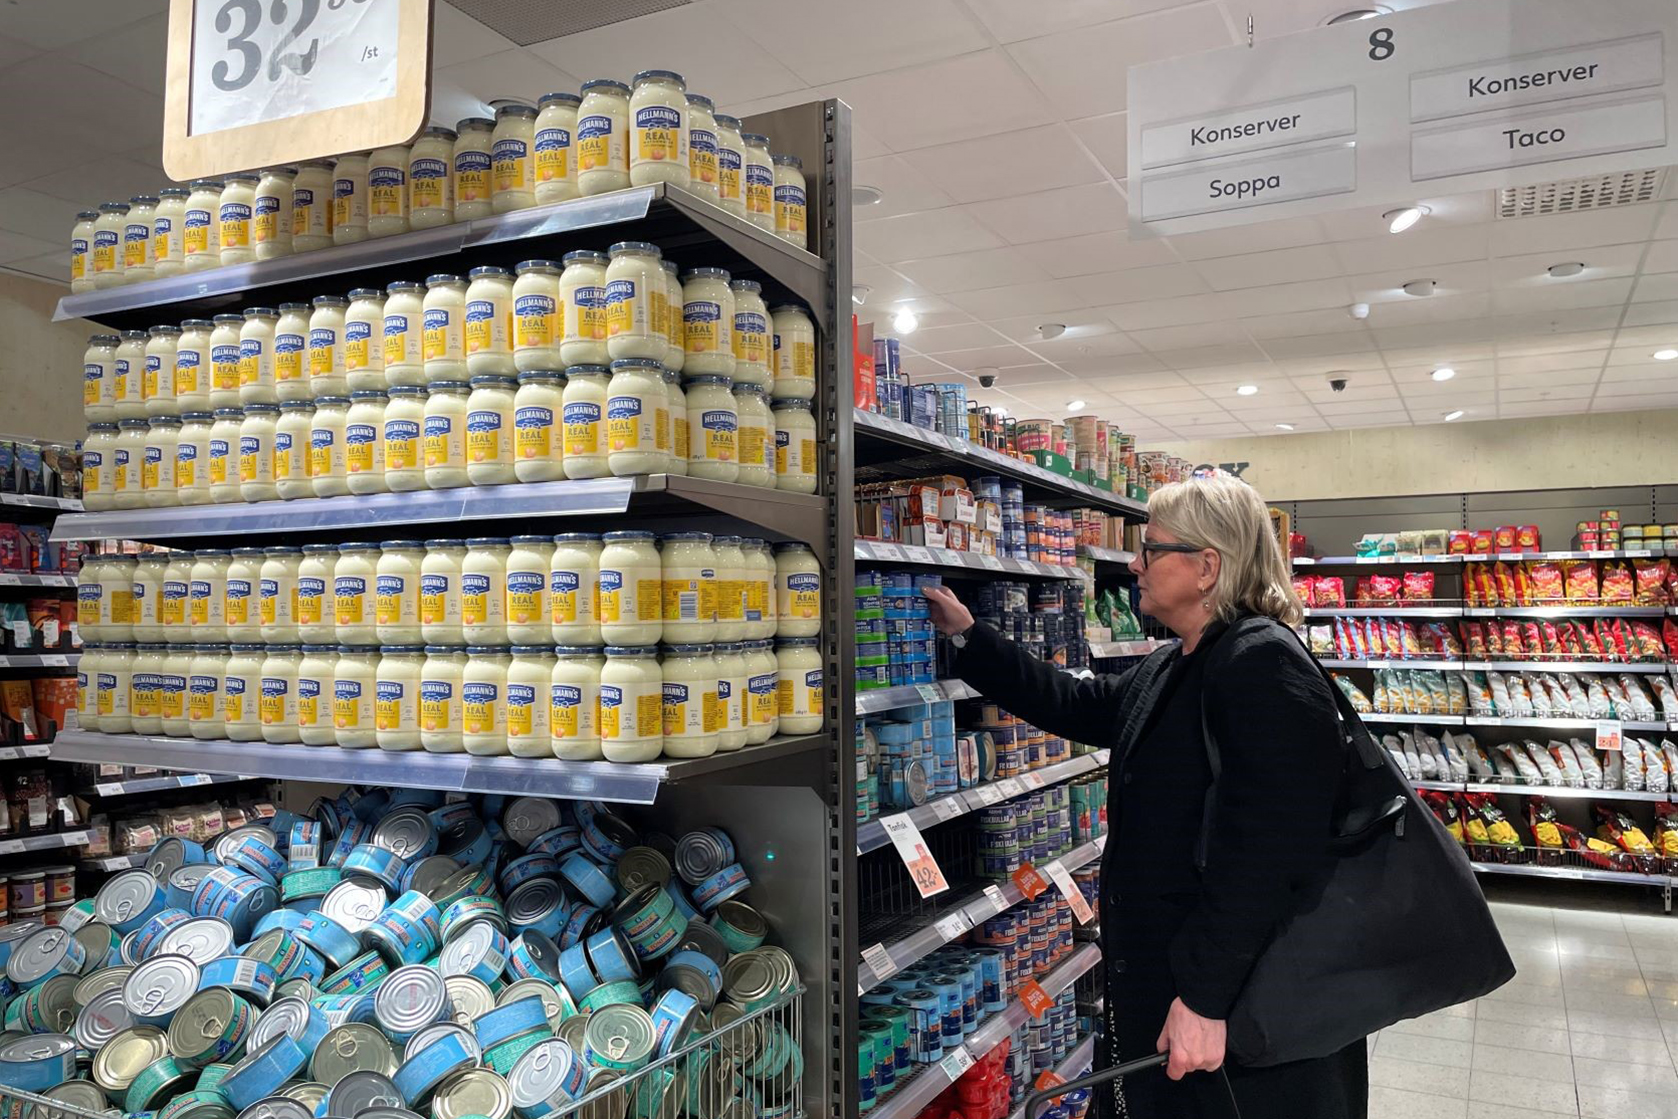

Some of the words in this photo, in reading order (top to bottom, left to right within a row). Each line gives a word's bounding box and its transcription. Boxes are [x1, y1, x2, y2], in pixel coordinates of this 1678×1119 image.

[1368, 28, 1394, 60] 8
[361, 46, 378, 62] /st
[1469, 61, 1598, 98] Konserver
[638, 109, 679, 124] HELLMANN'S
[1191, 114, 1300, 146] Konserver
[645, 130, 672, 142] REAL
[1503, 126, 1566, 150] Taco
[581, 141, 602, 152] REAL
[538, 152, 560, 163] REAL
[460, 174, 482, 184] REAL
[414, 181, 437, 190] REAL
[1210, 172, 1280, 199] Soppa
[522, 318, 546, 328] REAL
[688, 326, 711, 334] REAL
[568, 427, 590, 436] REAL
[610, 422, 630, 430] REAL
[520, 432, 542, 440] REAL
[712, 434, 733, 442] REAL
[512, 596, 534, 604] REAL
[466, 706, 486, 714] REAL
[888, 821, 908, 832] Tonfisk
[628, 912, 659, 936] TONFISK
[647, 930, 675, 951] TONFISK
